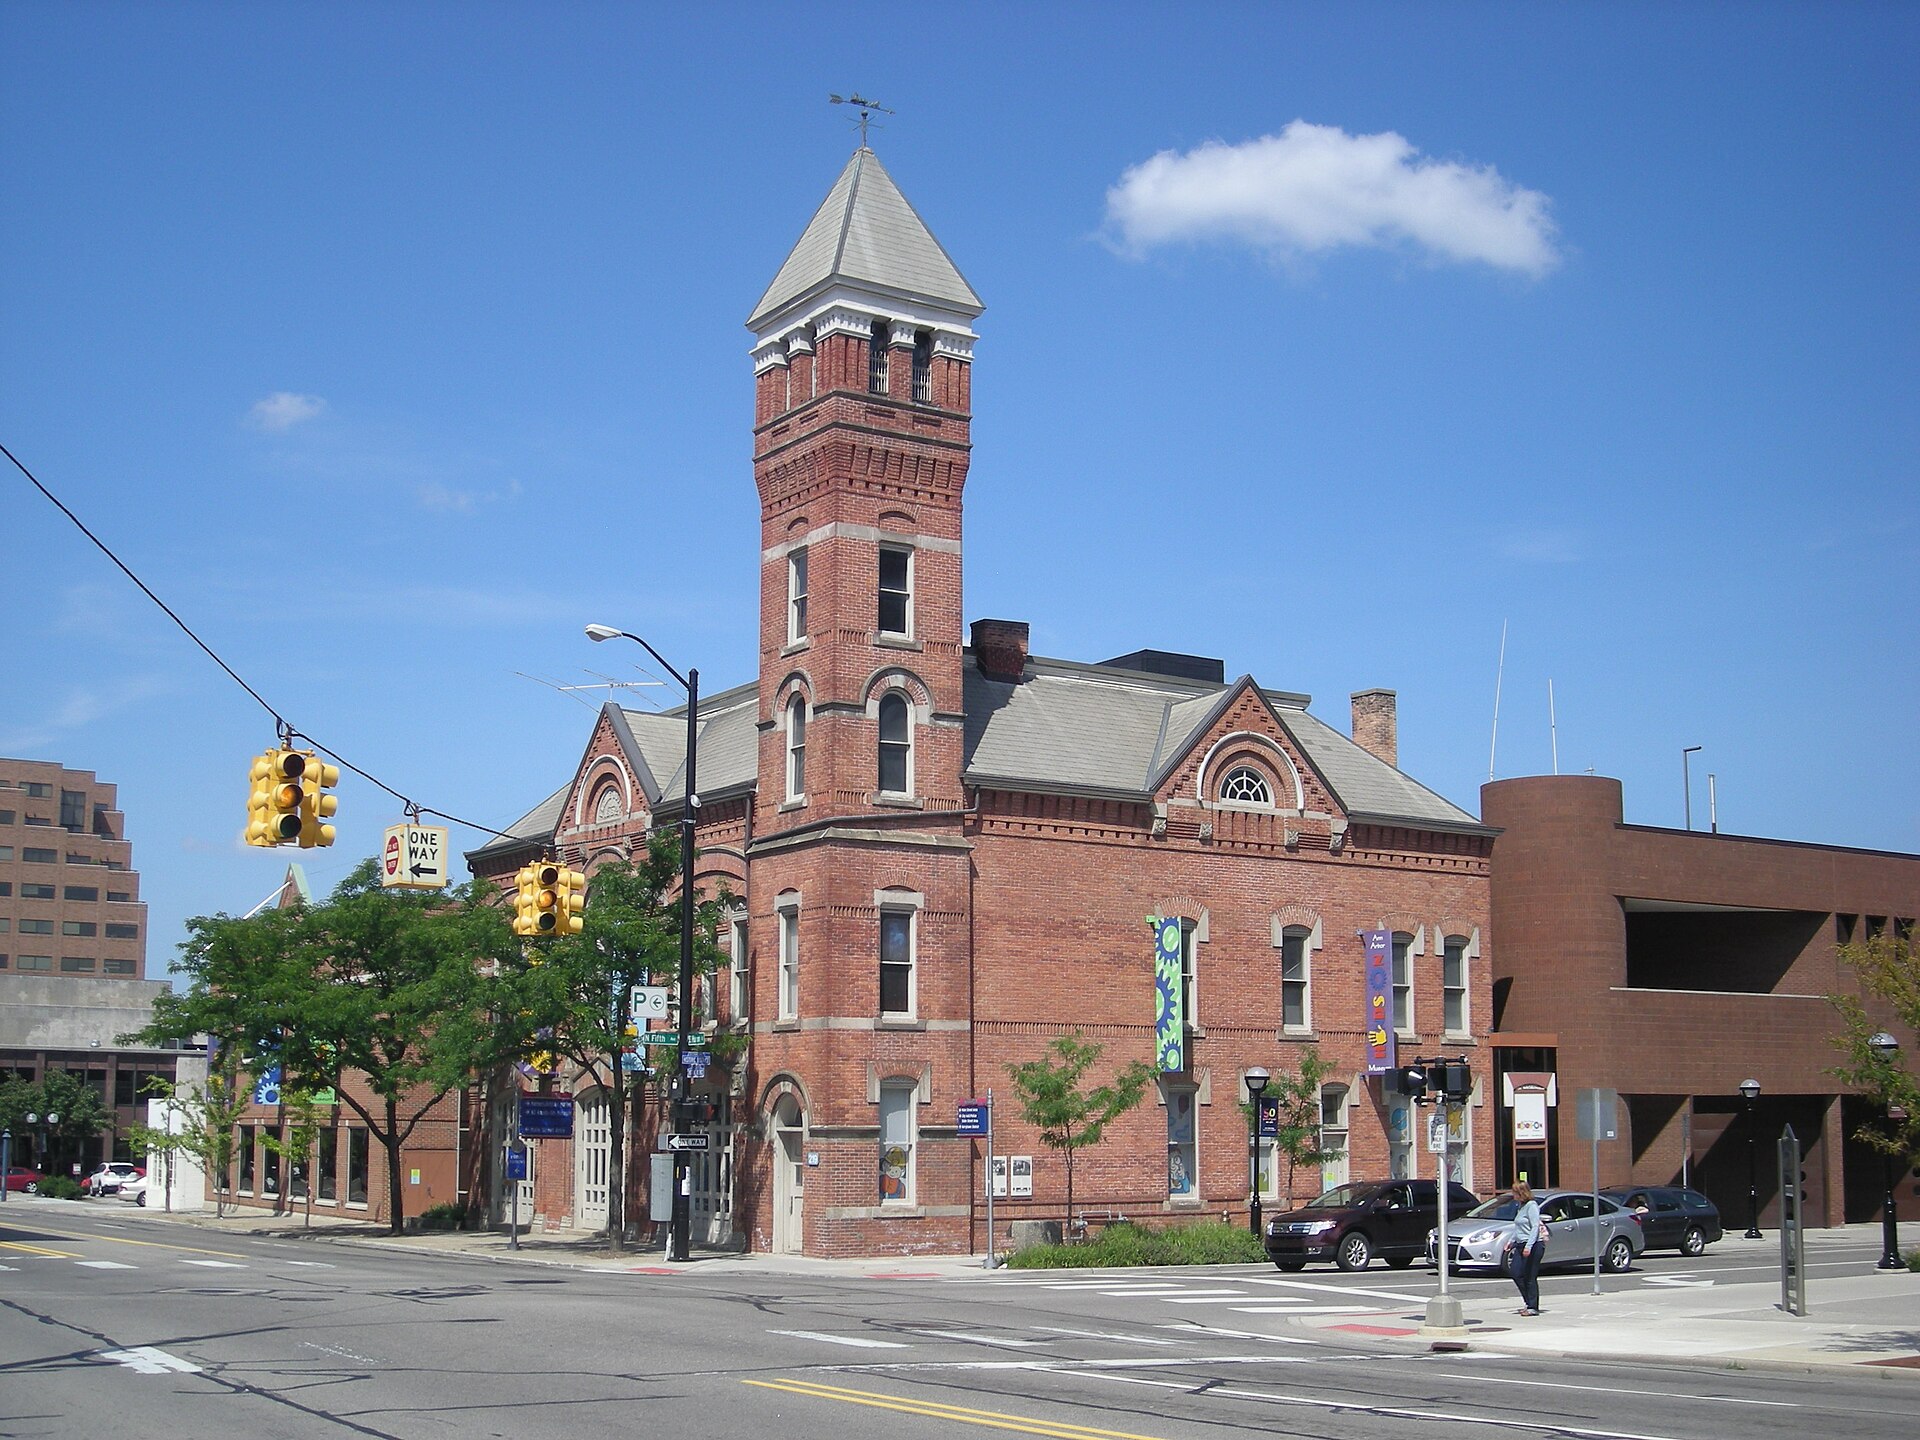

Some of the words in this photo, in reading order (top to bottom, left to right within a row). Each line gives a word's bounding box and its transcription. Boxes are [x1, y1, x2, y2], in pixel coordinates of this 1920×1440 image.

[410, 831, 437, 846] ONE
[409, 846, 438, 861] WAY
[1372, 934, 1384, 942] Ann
[1370, 942, 1386, 950] Arbor
[633, 992, 647, 1013] P
[644, 1034, 650, 1042] N
[651, 1034, 666, 1043] Fifth
[1368, 1064, 1392, 1072] Muse
[1263, 1107, 1276, 1118] 50
